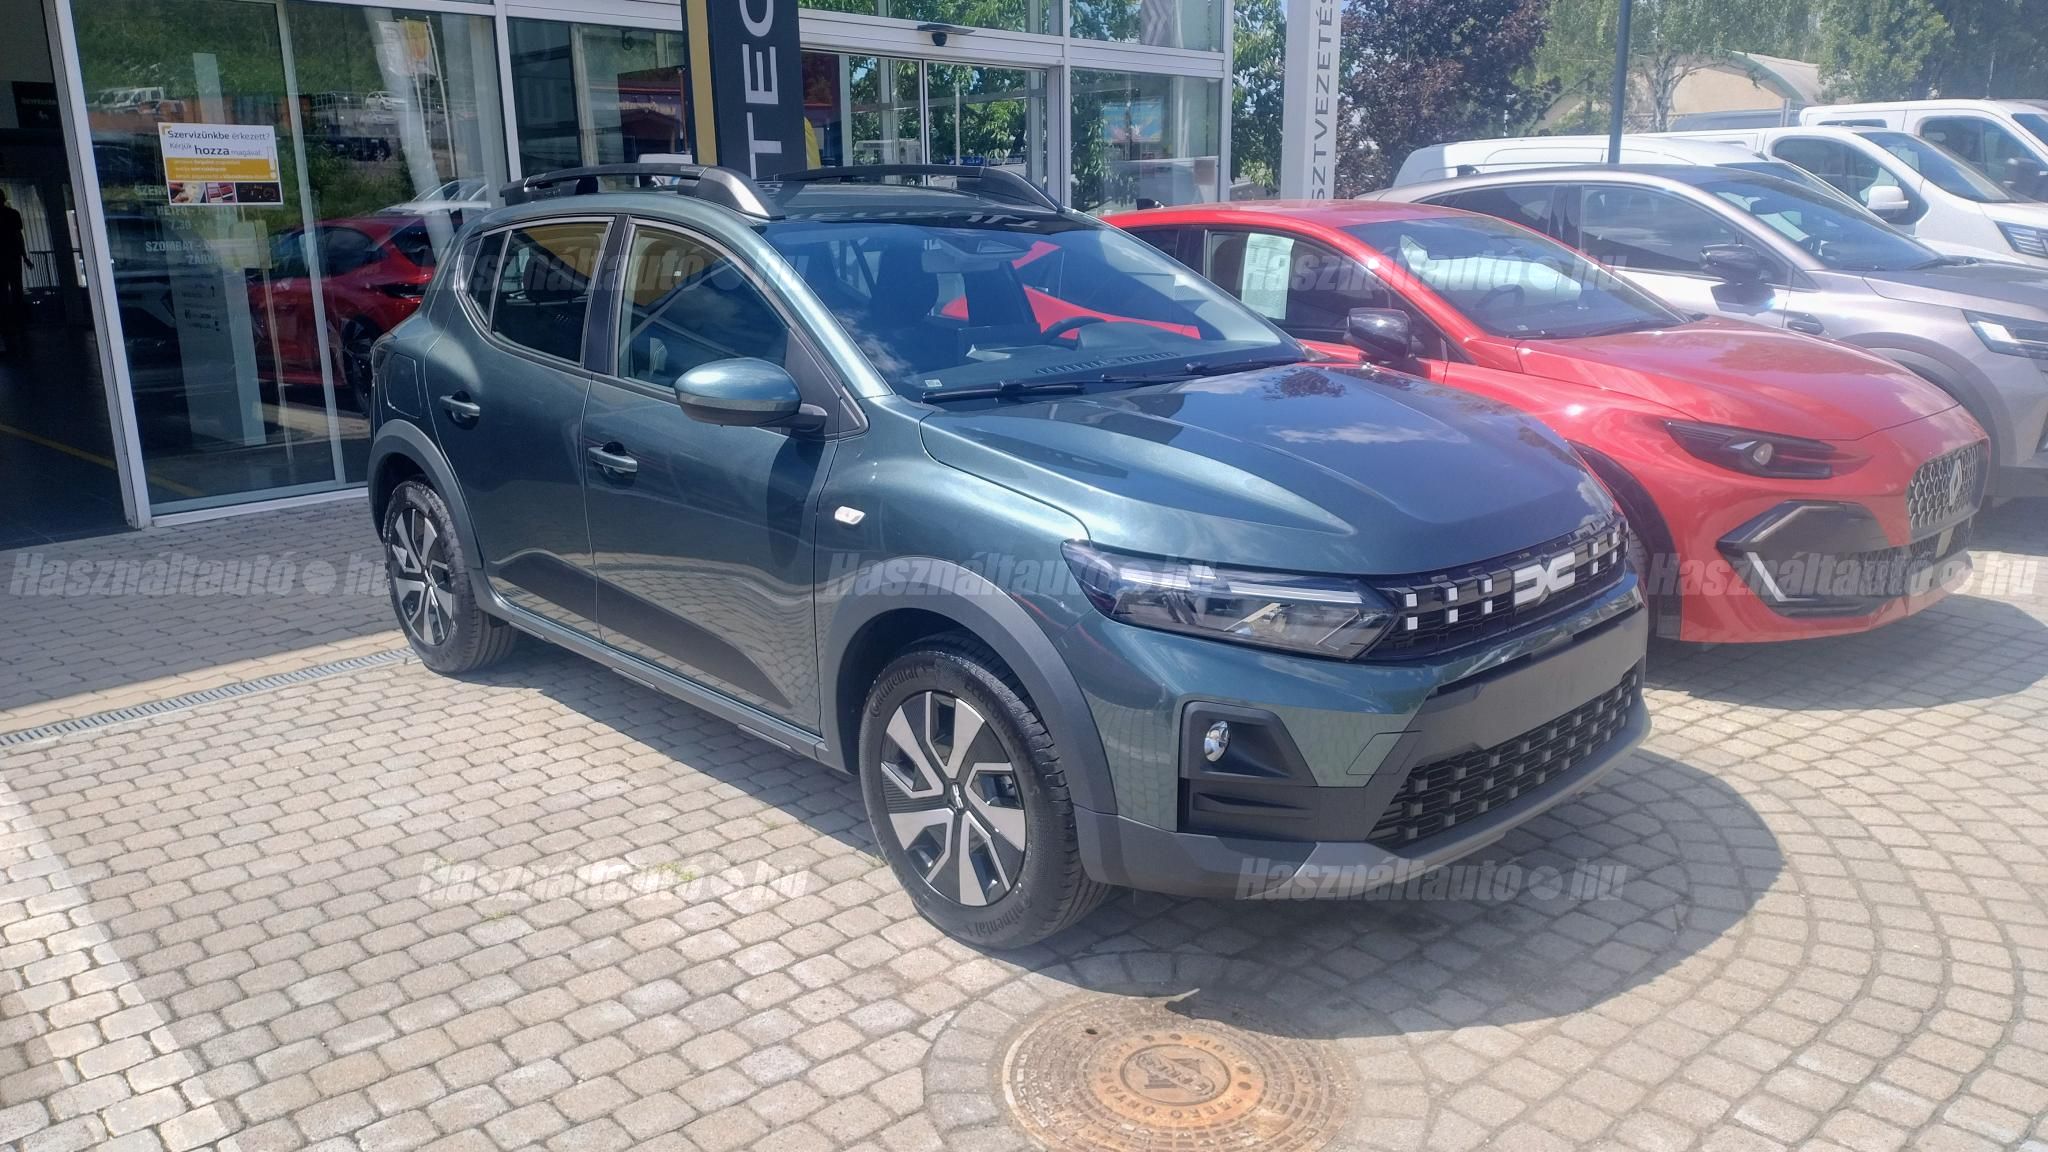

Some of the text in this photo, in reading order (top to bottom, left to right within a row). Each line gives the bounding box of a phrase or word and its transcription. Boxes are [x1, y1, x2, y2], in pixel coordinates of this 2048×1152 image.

[1311, 0, 1334, 200] SZTVEZETÉ
[167, 130, 230, 141] Szervizünkbe
[195, 145, 230, 156] hozza
[146, 241, 193, 252] SZOMBAT
